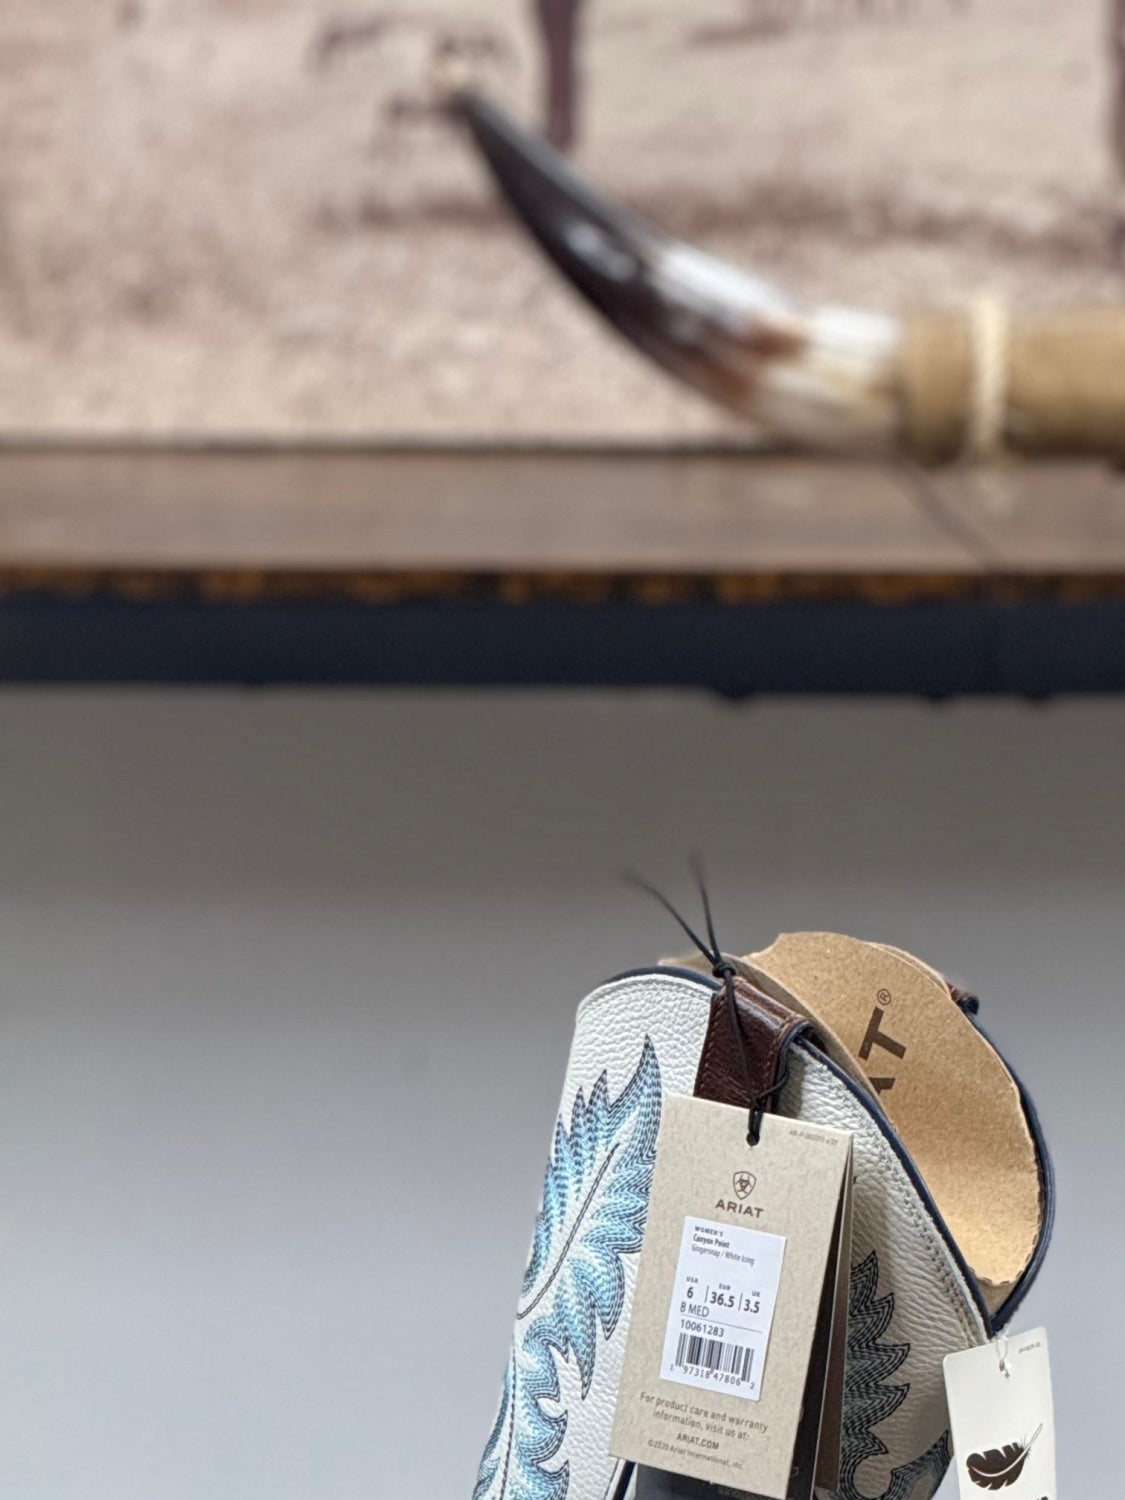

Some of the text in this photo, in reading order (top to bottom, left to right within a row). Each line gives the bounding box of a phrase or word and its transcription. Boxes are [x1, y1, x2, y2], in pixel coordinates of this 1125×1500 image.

[715, 1199, 764, 1218] ARIAT
[718, 1283, 731, 1291] EUR
[686, 1286, 760, 1314] 6 36.5 3.5
[680, 1301, 710, 1318] B MED
[681, 1319, 725, 1337] 10061283
[713, 1372, 741, 1386] 47806
[749, 1382, 755, 1390] 2
[640, 1391, 768, 1434] For product care and warranty
[653, 1409, 750, 1441] information, visit us at:
[676, 1433, 720, 1450] ARIAT.COM
